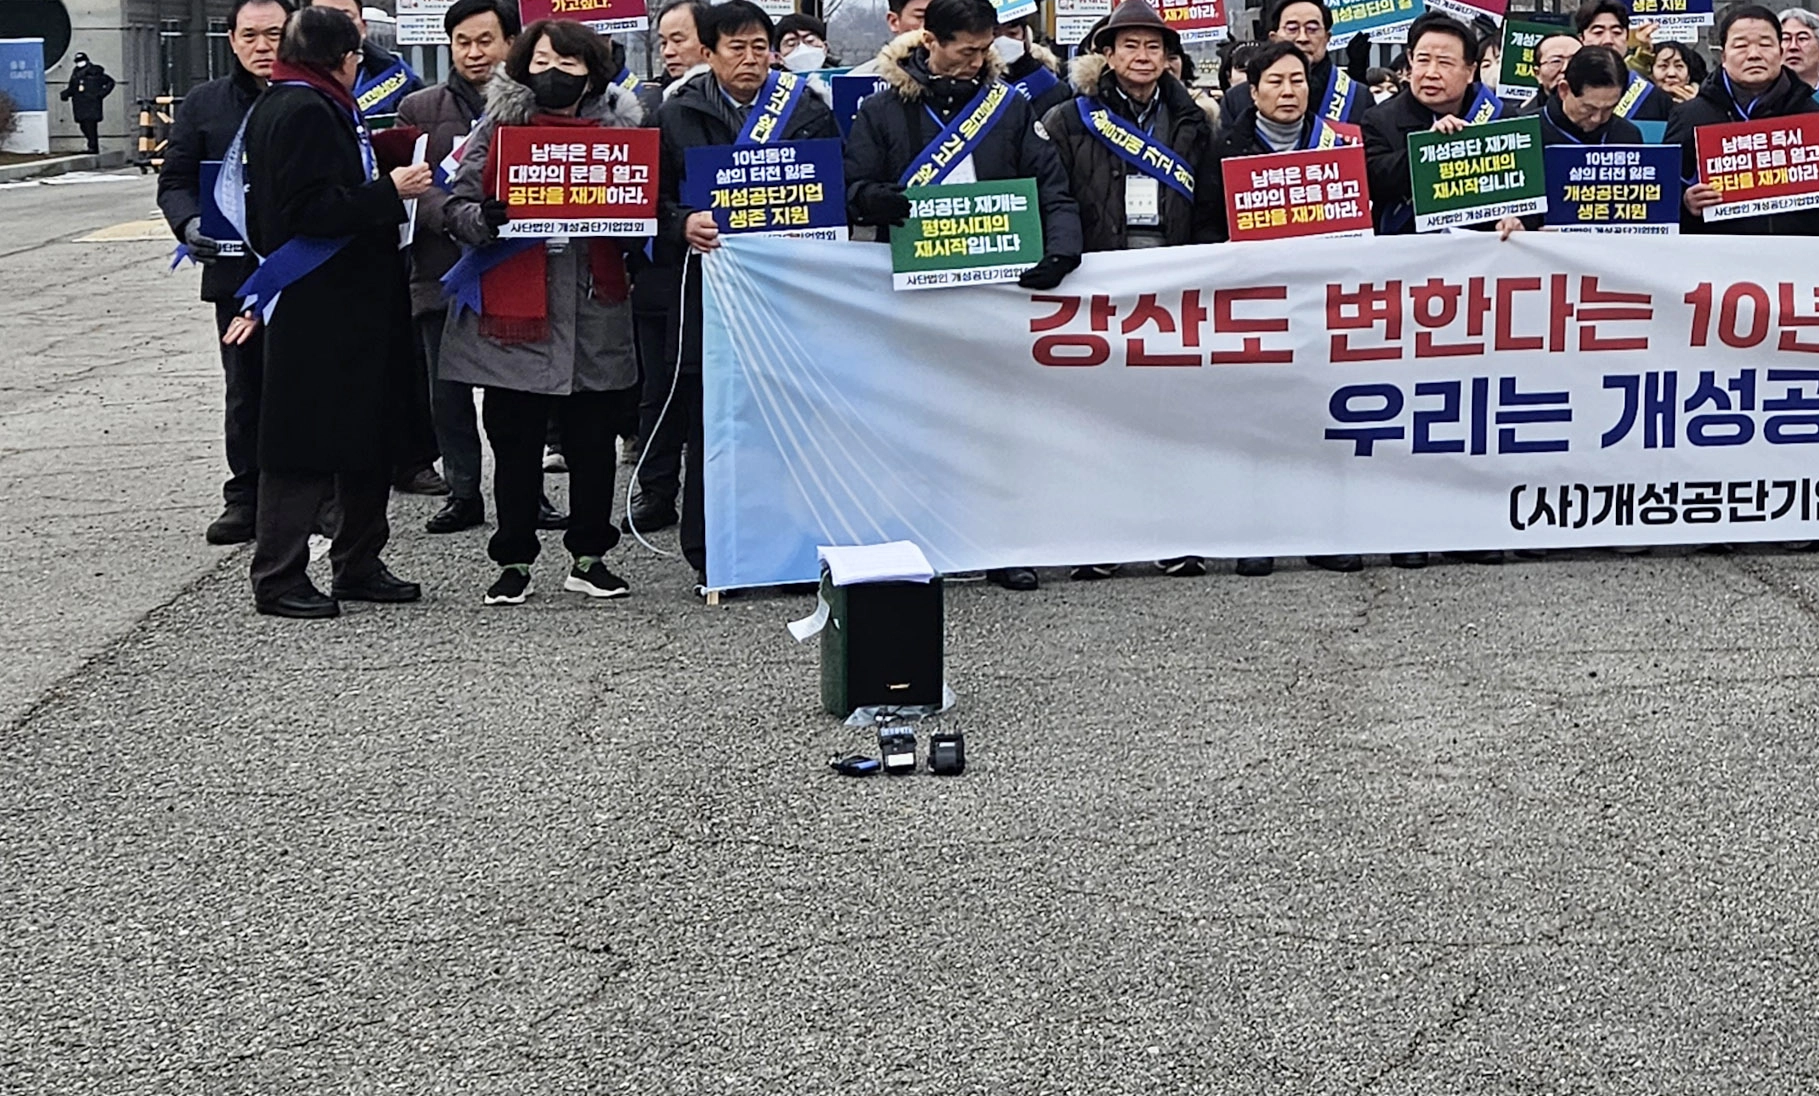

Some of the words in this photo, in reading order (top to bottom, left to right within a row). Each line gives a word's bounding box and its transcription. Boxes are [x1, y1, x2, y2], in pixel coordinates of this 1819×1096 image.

[1419, 138, 1481, 163] 개성공단
[1485, 132, 1531, 153] 재개는
[1722, 133, 1768, 154] 남북은
[1771, 128, 1802, 147] 즉시
[531, 144, 587, 162] 남북은
[592, 144, 629, 162] 즉시
[732, 147, 796, 166] 10년동안
[1142, 145, 1174, 175] 가고
[1585, 151, 1640, 165] 10년동안
[1706, 153, 1752, 174] 대화의
[1756, 149, 1787, 168] 문을
[508, 165, 565, 183] 대화의
[570, 165, 607, 183] 문을
[612, 165, 649, 183] 열고
[716, 168, 746, 184] 삶의
[750, 165, 781, 181] 터전
[784, 163, 816, 180] 잃은
[1251, 167, 1301, 188] 남북은
[1305, 162, 1339, 181] 즉시
[1439, 152, 1515, 179] 평화시대의
[1569, 167, 1596, 181] 삶의
[1599, 167, 1626, 181] 터전
[1629, 166, 1656, 181] 잃은
[1433, 170, 1525, 200] 재시작입니다
[1563, 184, 1661, 201] 개성공단기업
[1708, 171, 1754, 192] 공단을
[508, 187, 564, 205] 공단을
[569, 186, 648, 205] 재개하라.
[710, 182, 824, 208] 개성공단기업
[974, 194, 1027, 213] 재개는
[1235, 188, 1285, 210] 대화의
[1289, 184, 1322, 204] 문을
[1326, 180, 1360, 200] 열고
[729, 208, 766, 228] 생존
[771, 205, 809, 225] 지원
[1237, 208, 1287, 230] 공단을
[1291, 200, 1363, 223] 재개하라.
[1577, 203, 1609, 220] 생존
[1613, 203, 1647, 220] 지원
[922, 214, 1010, 237] 평화시대의
[914, 234, 1021, 258] 재시작입니다
[1030, 286, 1293, 367] 강산도
[1326, 274, 1653, 363] 변한다는
[1325, 377, 1572, 456] 우리는
